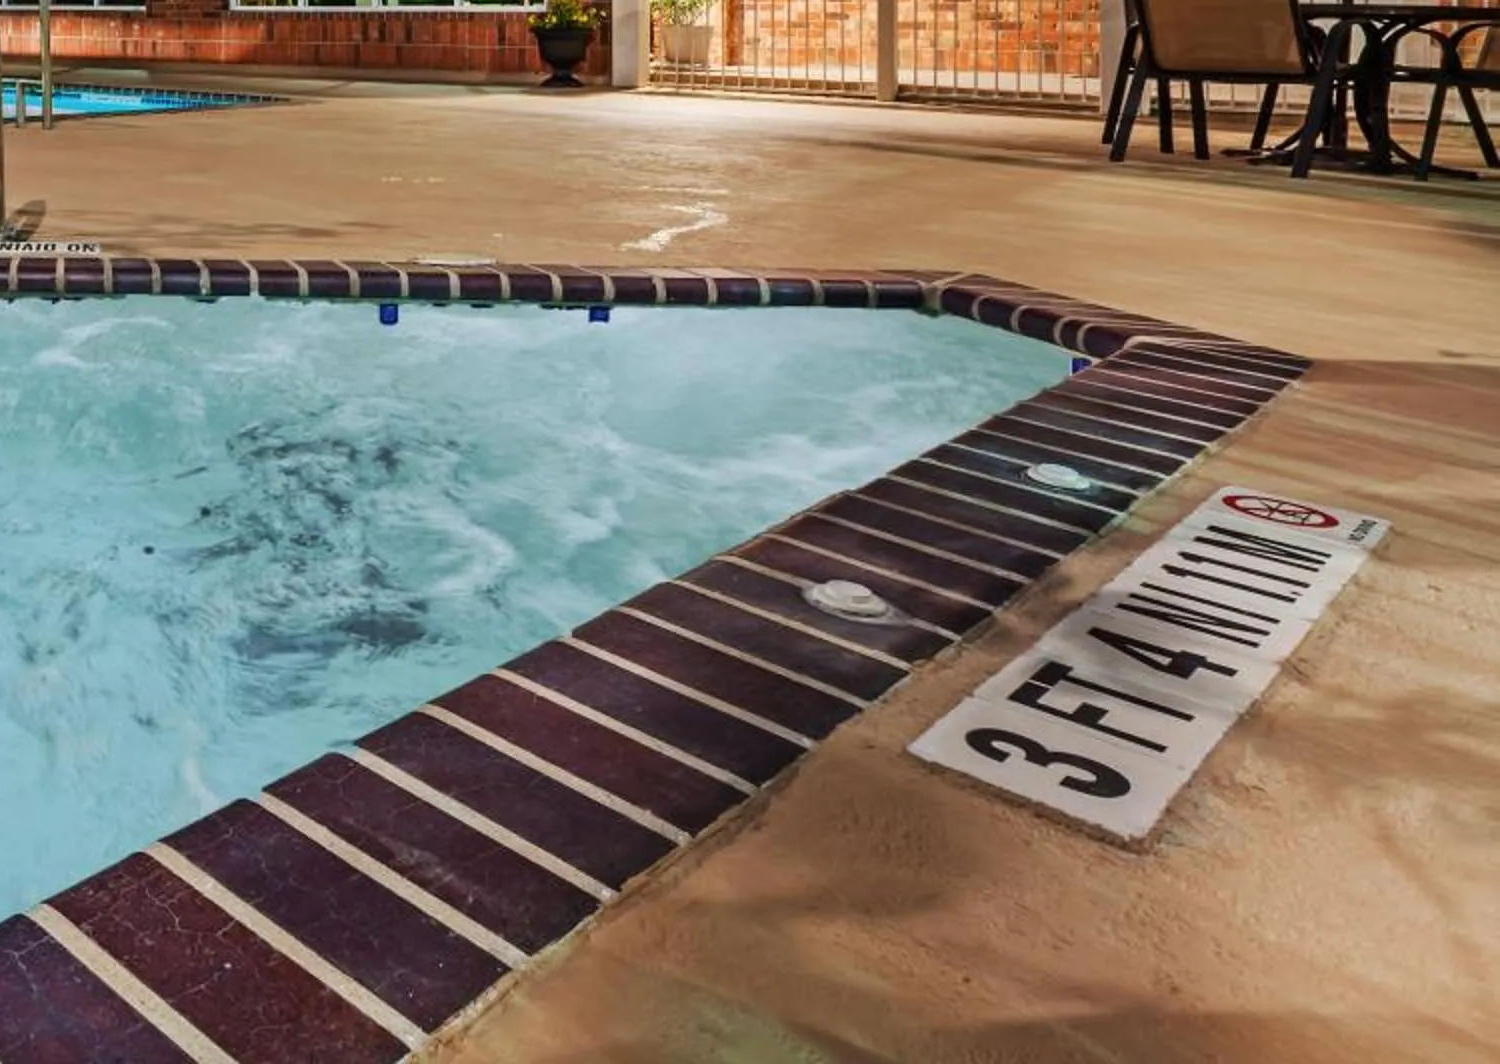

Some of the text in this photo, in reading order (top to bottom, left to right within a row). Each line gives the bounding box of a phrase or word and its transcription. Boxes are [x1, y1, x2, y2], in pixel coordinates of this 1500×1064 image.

[66, 243, 97, 252] NO
[1192, 524, 1334, 573] M
[1087, 626, 1240, 680] 4
[1007, 660, 1196, 753] FT
[964, 727, 1132, 799] 3
